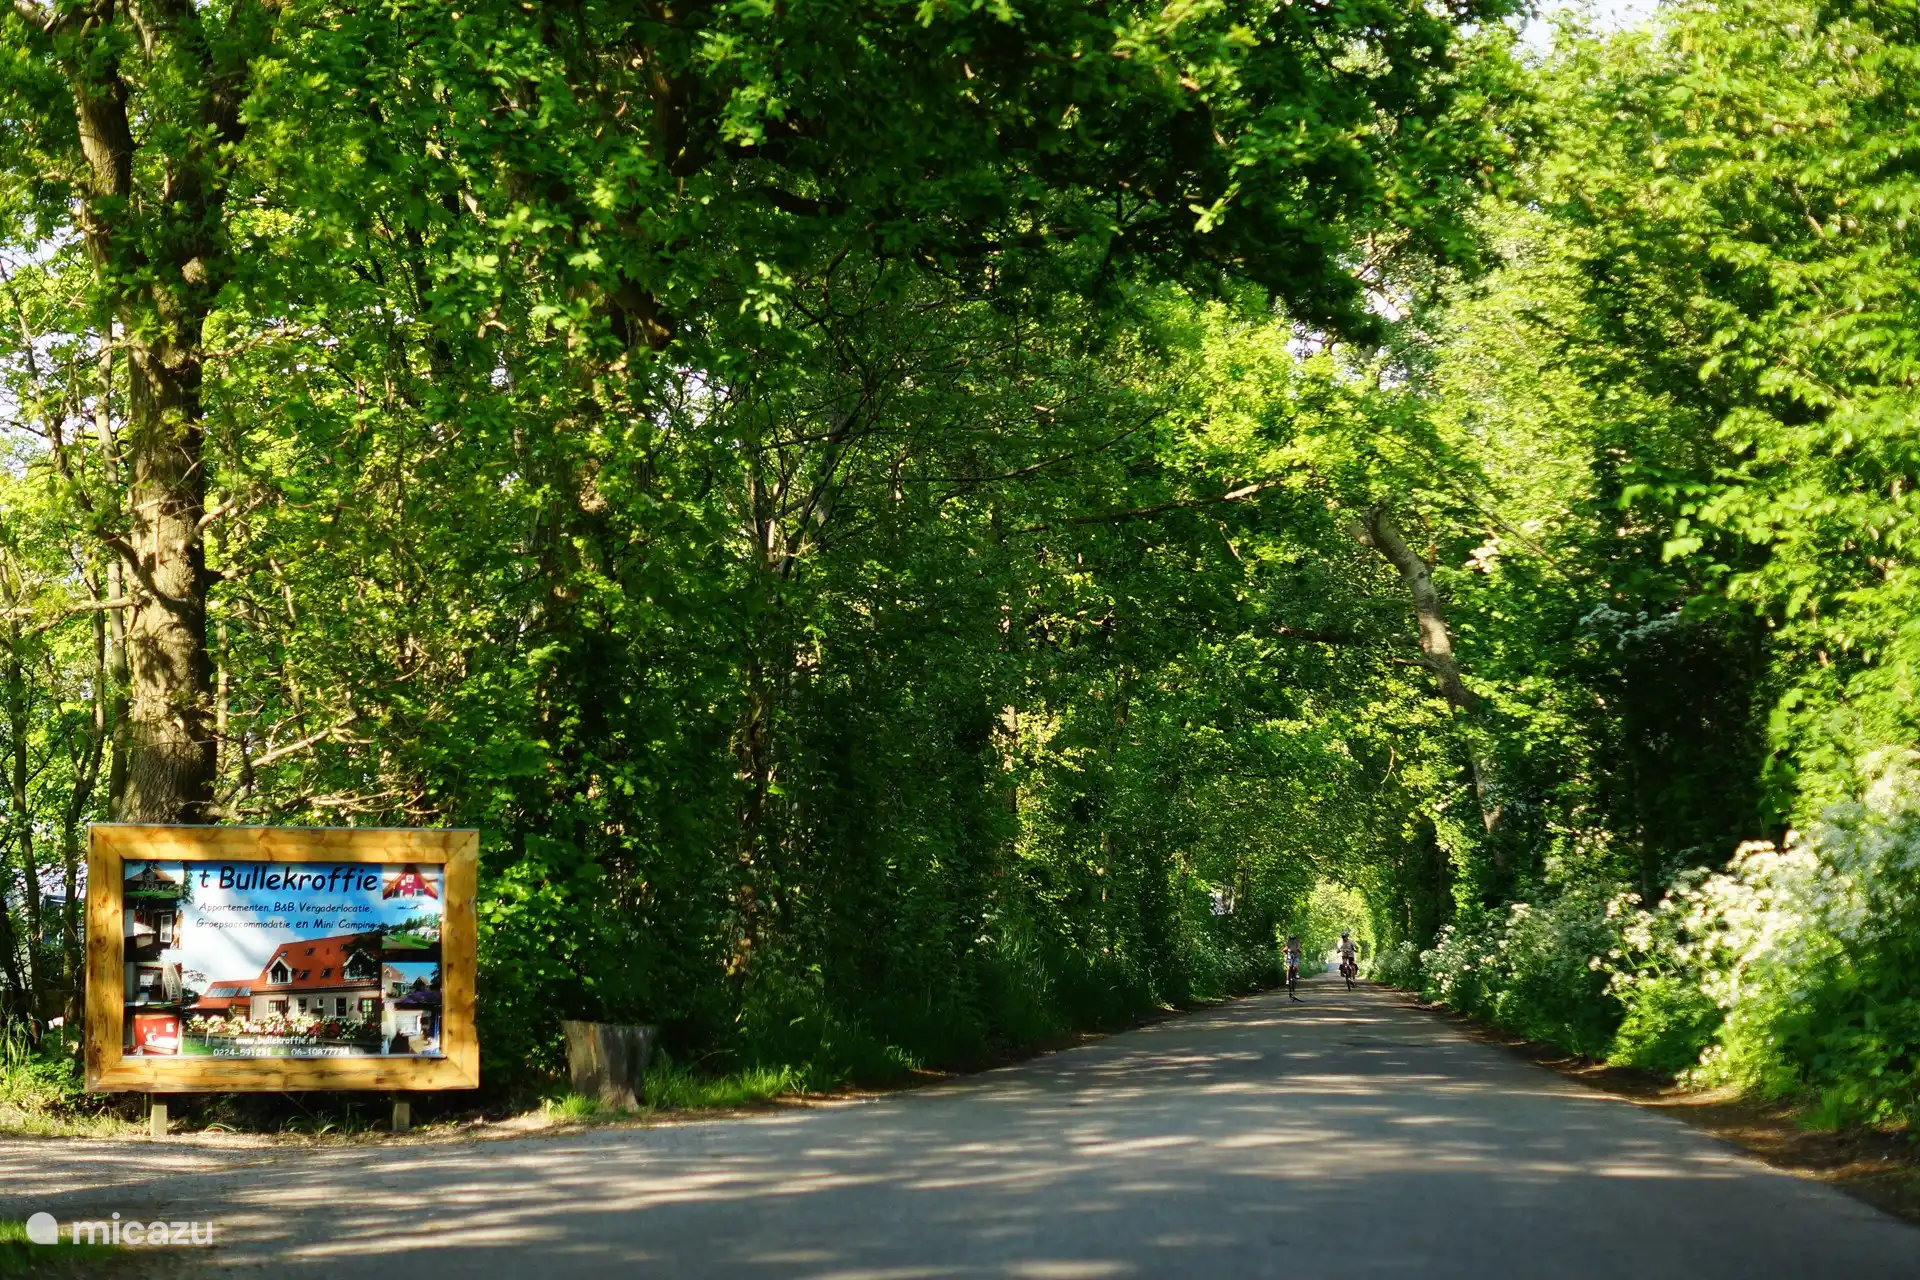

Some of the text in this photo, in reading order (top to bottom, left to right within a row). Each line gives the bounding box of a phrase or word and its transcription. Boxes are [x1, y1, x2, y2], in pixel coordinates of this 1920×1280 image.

[219, 865, 378, 893] Bullekroffie
[196, 917, 291, 930] Groepsaccommodatie
[295, 921, 309, 929] en
[313, 919, 334, 929] Mini
[235, 1035, 317, 1046] www.bullekroffie.nl
